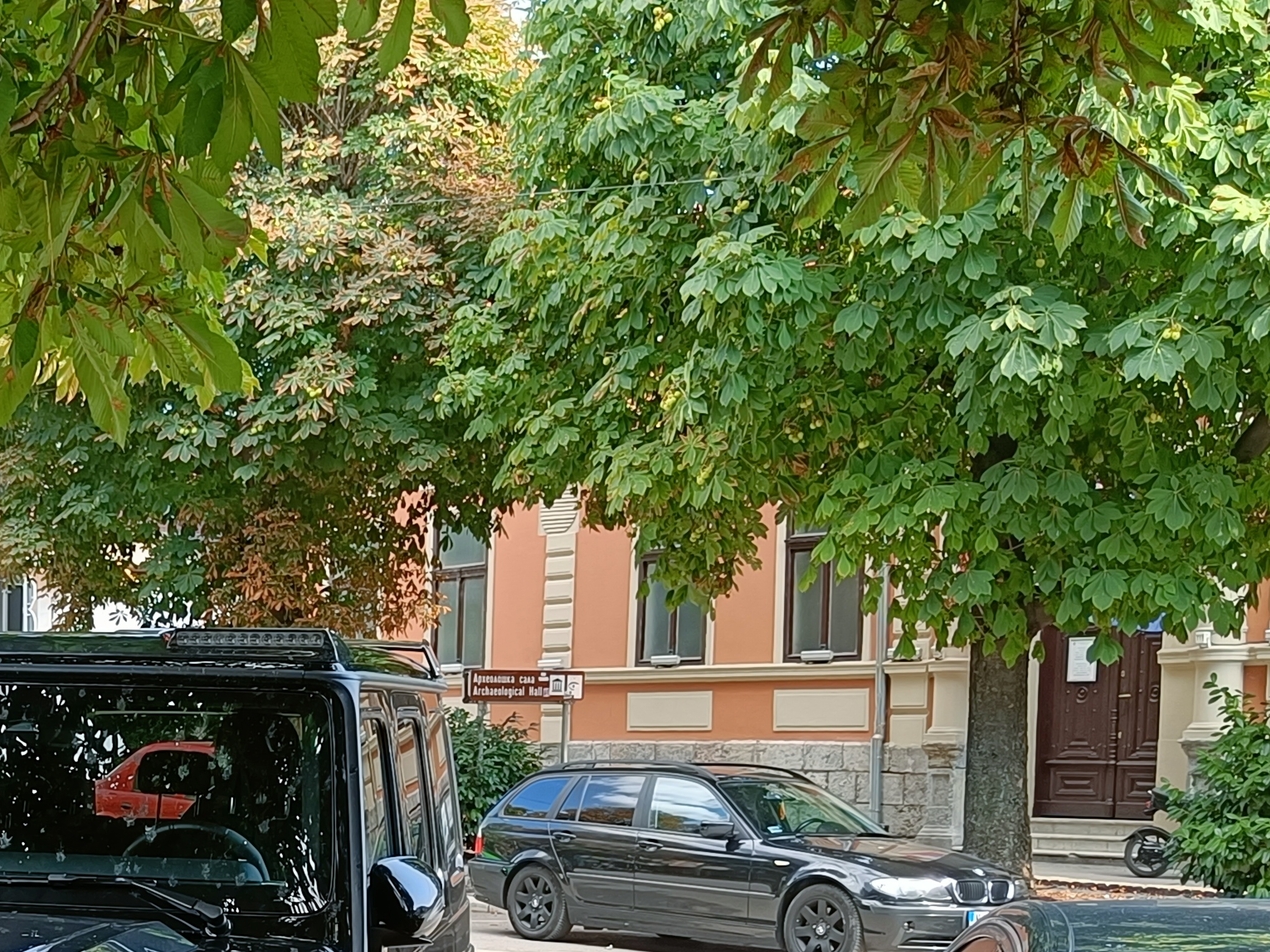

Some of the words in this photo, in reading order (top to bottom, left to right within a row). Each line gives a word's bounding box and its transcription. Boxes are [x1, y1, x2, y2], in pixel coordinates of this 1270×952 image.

[519, 675, 535, 684] сала
[473, 686, 525, 698] Archaeological
[529, 686, 543, 696] Hall
